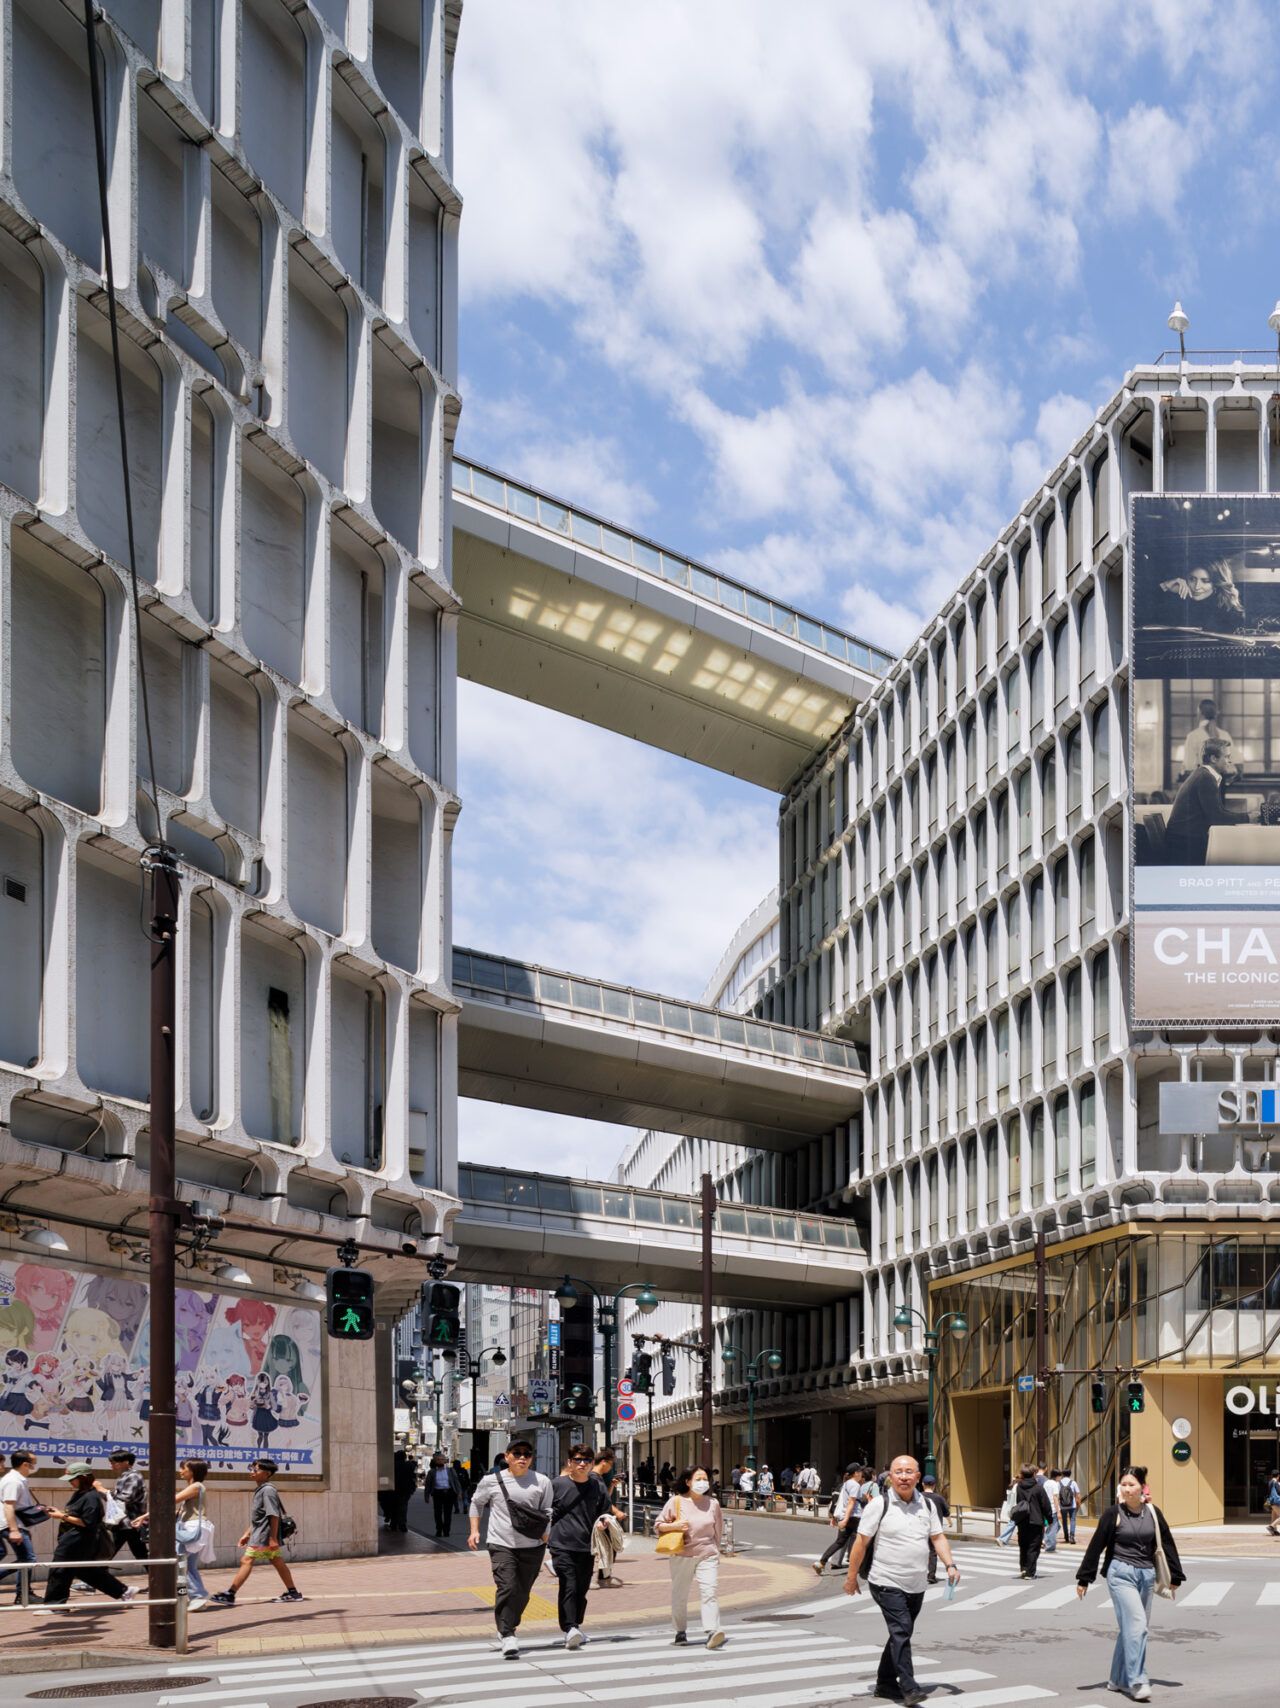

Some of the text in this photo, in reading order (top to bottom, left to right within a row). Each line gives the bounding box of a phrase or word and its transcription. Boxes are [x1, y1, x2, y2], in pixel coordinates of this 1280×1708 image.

[1179, 878, 1214, 888] BRAD
[1217, 878, 1246, 888] PITT
[1184, 972, 1217, 984] THE
[1221, 972, 1280, 984] ICONIC
[622, 1383, 632, 1392] 30
